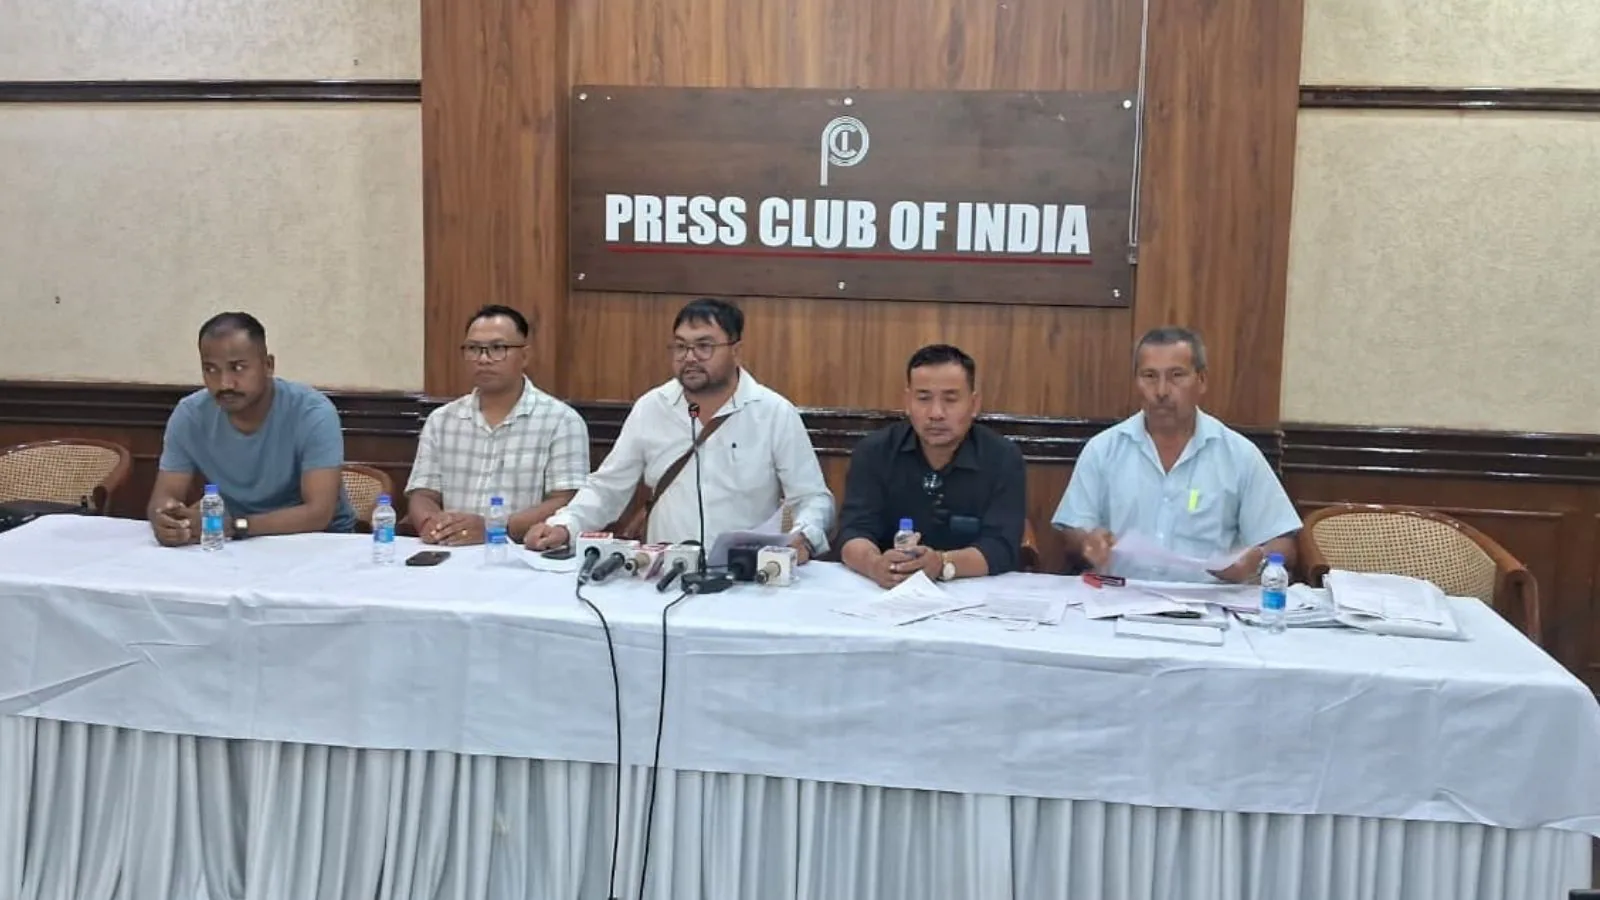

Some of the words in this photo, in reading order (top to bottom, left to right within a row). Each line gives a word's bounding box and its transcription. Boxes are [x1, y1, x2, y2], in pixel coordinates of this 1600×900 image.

[605, 193, 747, 246] PRESS
[758, 196, 877, 249] CLUB
[889, 200, 947, 251] OF
[956, 202, 1091, 255] INDIA
